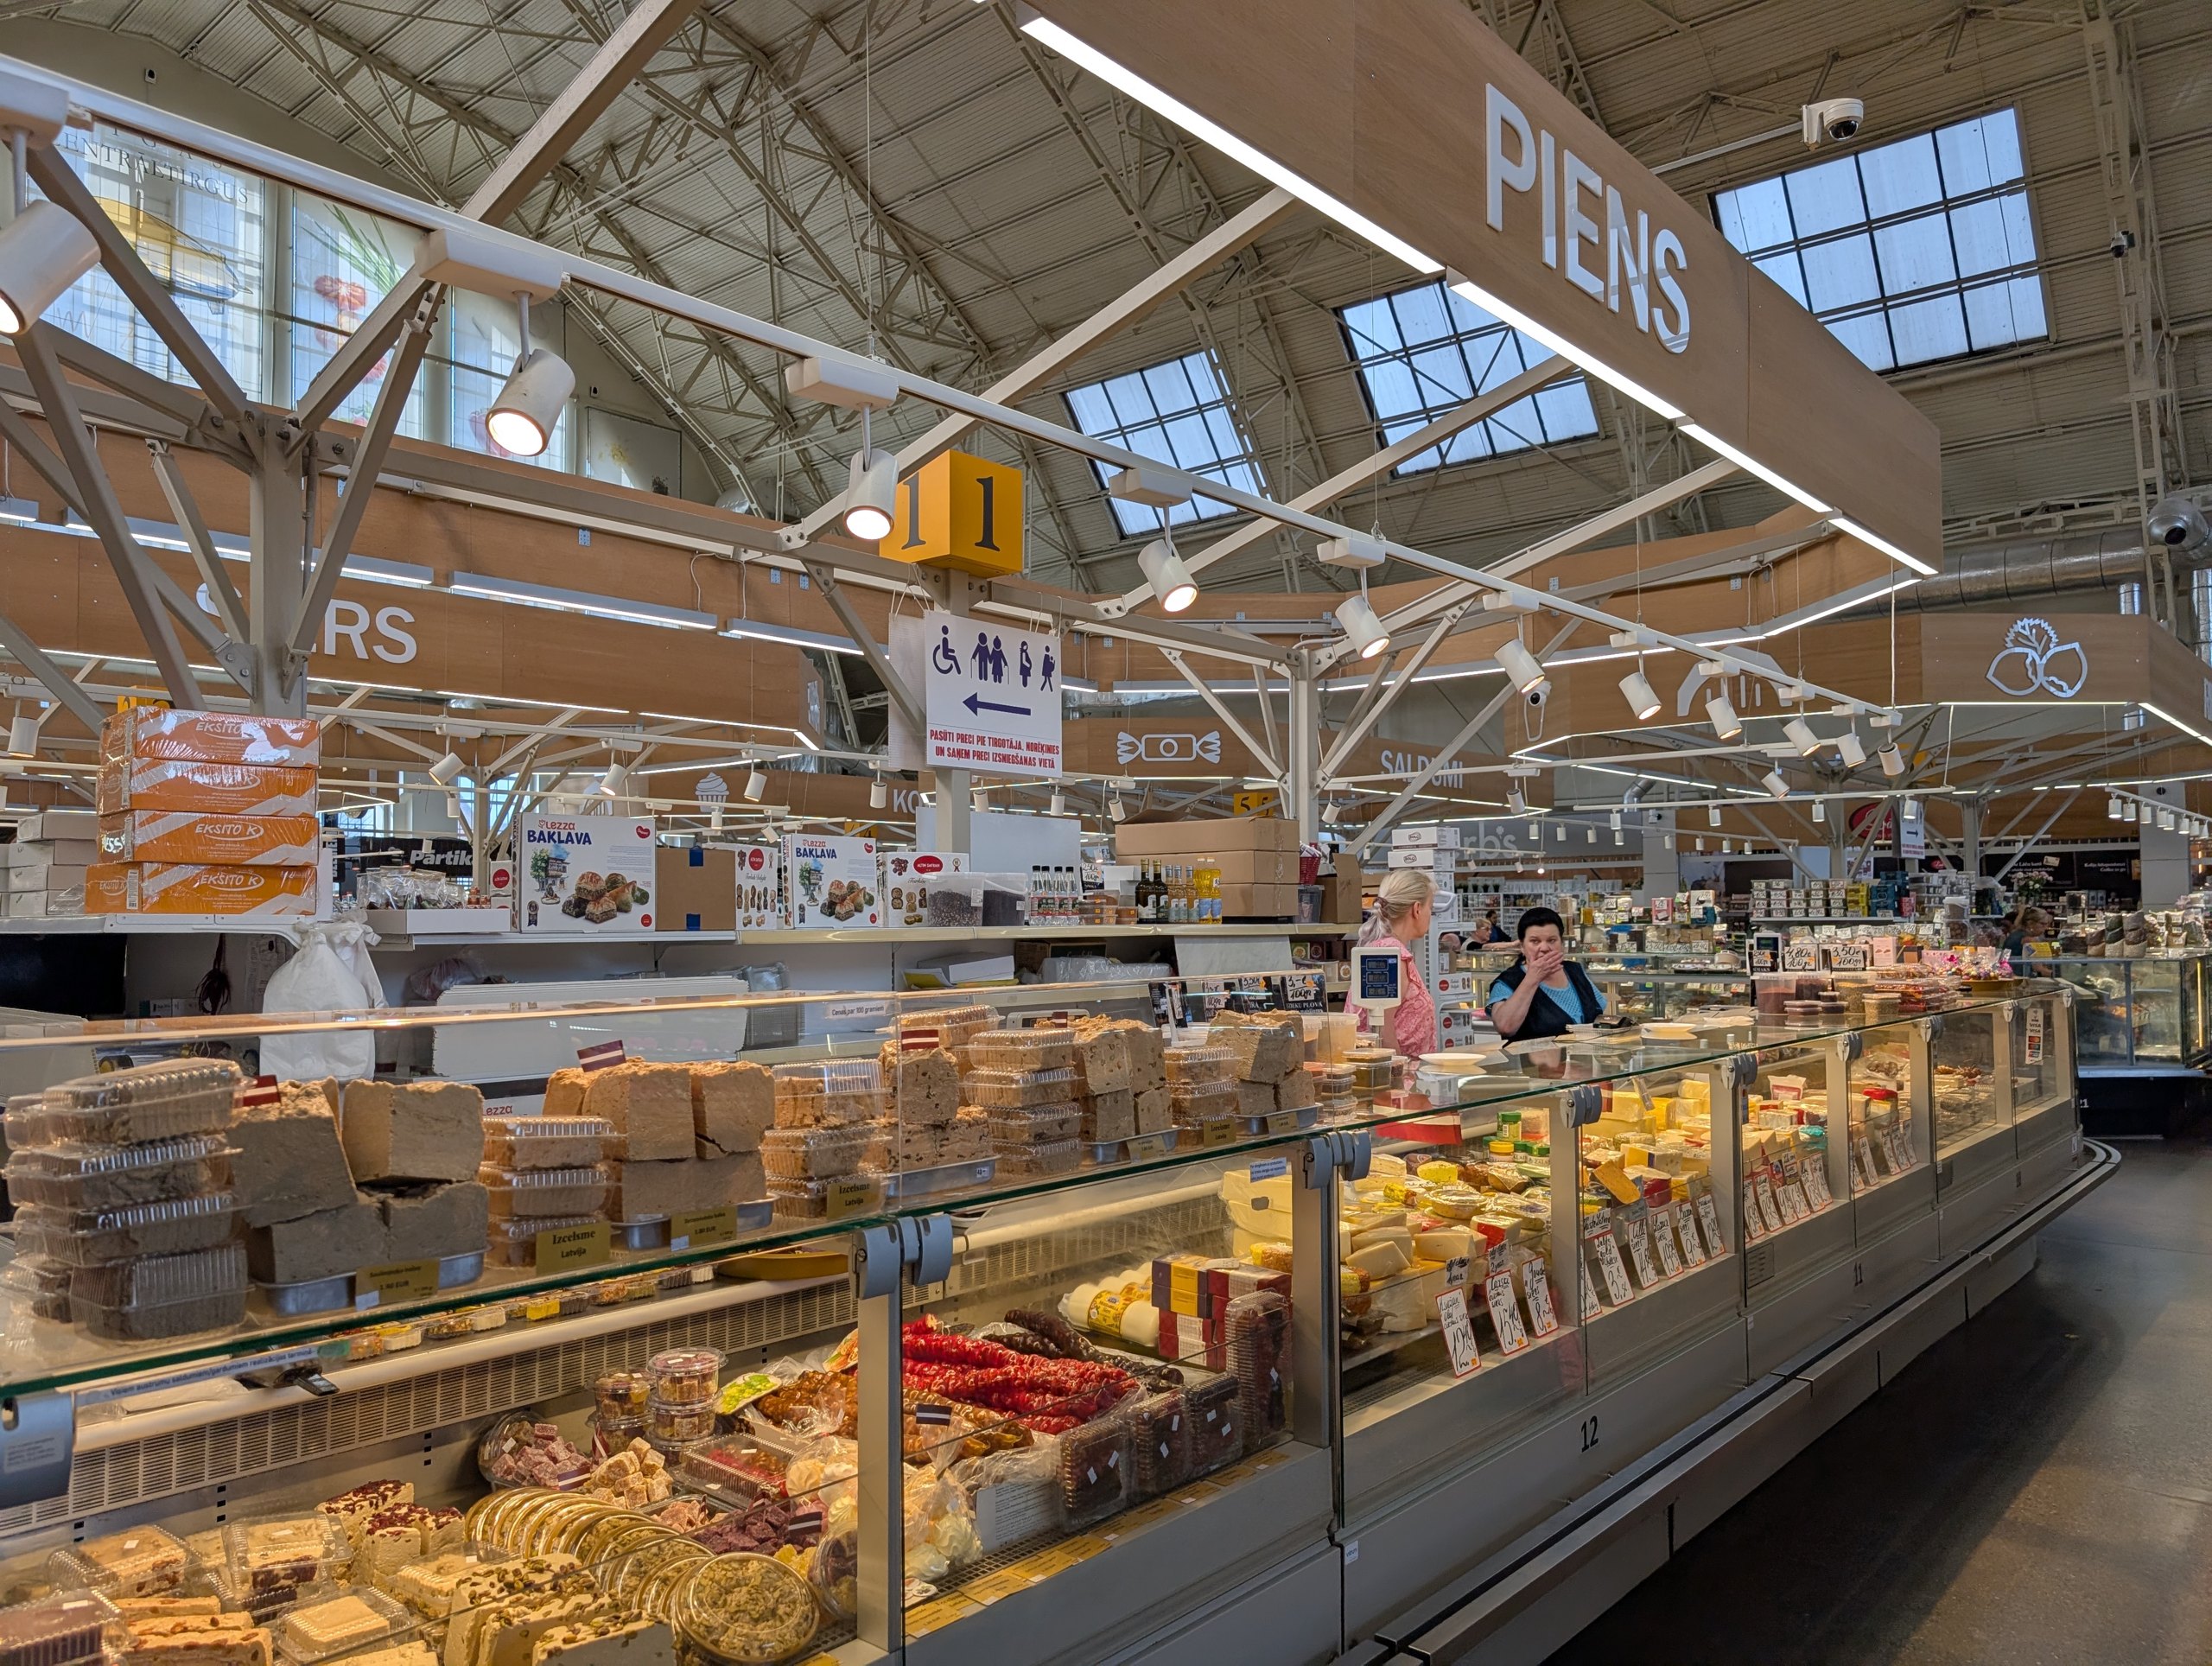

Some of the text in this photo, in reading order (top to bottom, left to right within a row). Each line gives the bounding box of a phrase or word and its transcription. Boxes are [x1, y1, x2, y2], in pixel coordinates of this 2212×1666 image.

[54, 131, 248, 204] ENTRĀLTIRGUS
[1484, 81, 1691, 355] PIENS
[901, 471, 926, 550] 1
[974, 476, 1001, 552] 1
[930, 728, 955, 742] PASŪTI
[956, 733, 974, 745] PRECI
[976, 734, 986, 747] PIE
[936, 746, 1055, 769] UN SAŅEM PRECI IZSNIEGŠANAS VIETĀ
[195, 823, 258, 836] EKSITO K
[527, 830, 593, 845] BAKLAVA
[410, 849, 473, 866] Pārtik
[795, 848, 837, 860] BAKLAVA
[200, 874, 259, 887] EKSITO K
[832, 1008, 846, 1016] Cenas
[482, 1105, 513, 1116] ezza
[839, 1182, 870, 1195] Izcelsme
[844, 1198, 864, 1206] Latvija
[552, 1230, 596, 1246] Izcelsme
[561, 1247, 587, 1259] Latvija
[1580, 1415, 1599, 1453] 12
